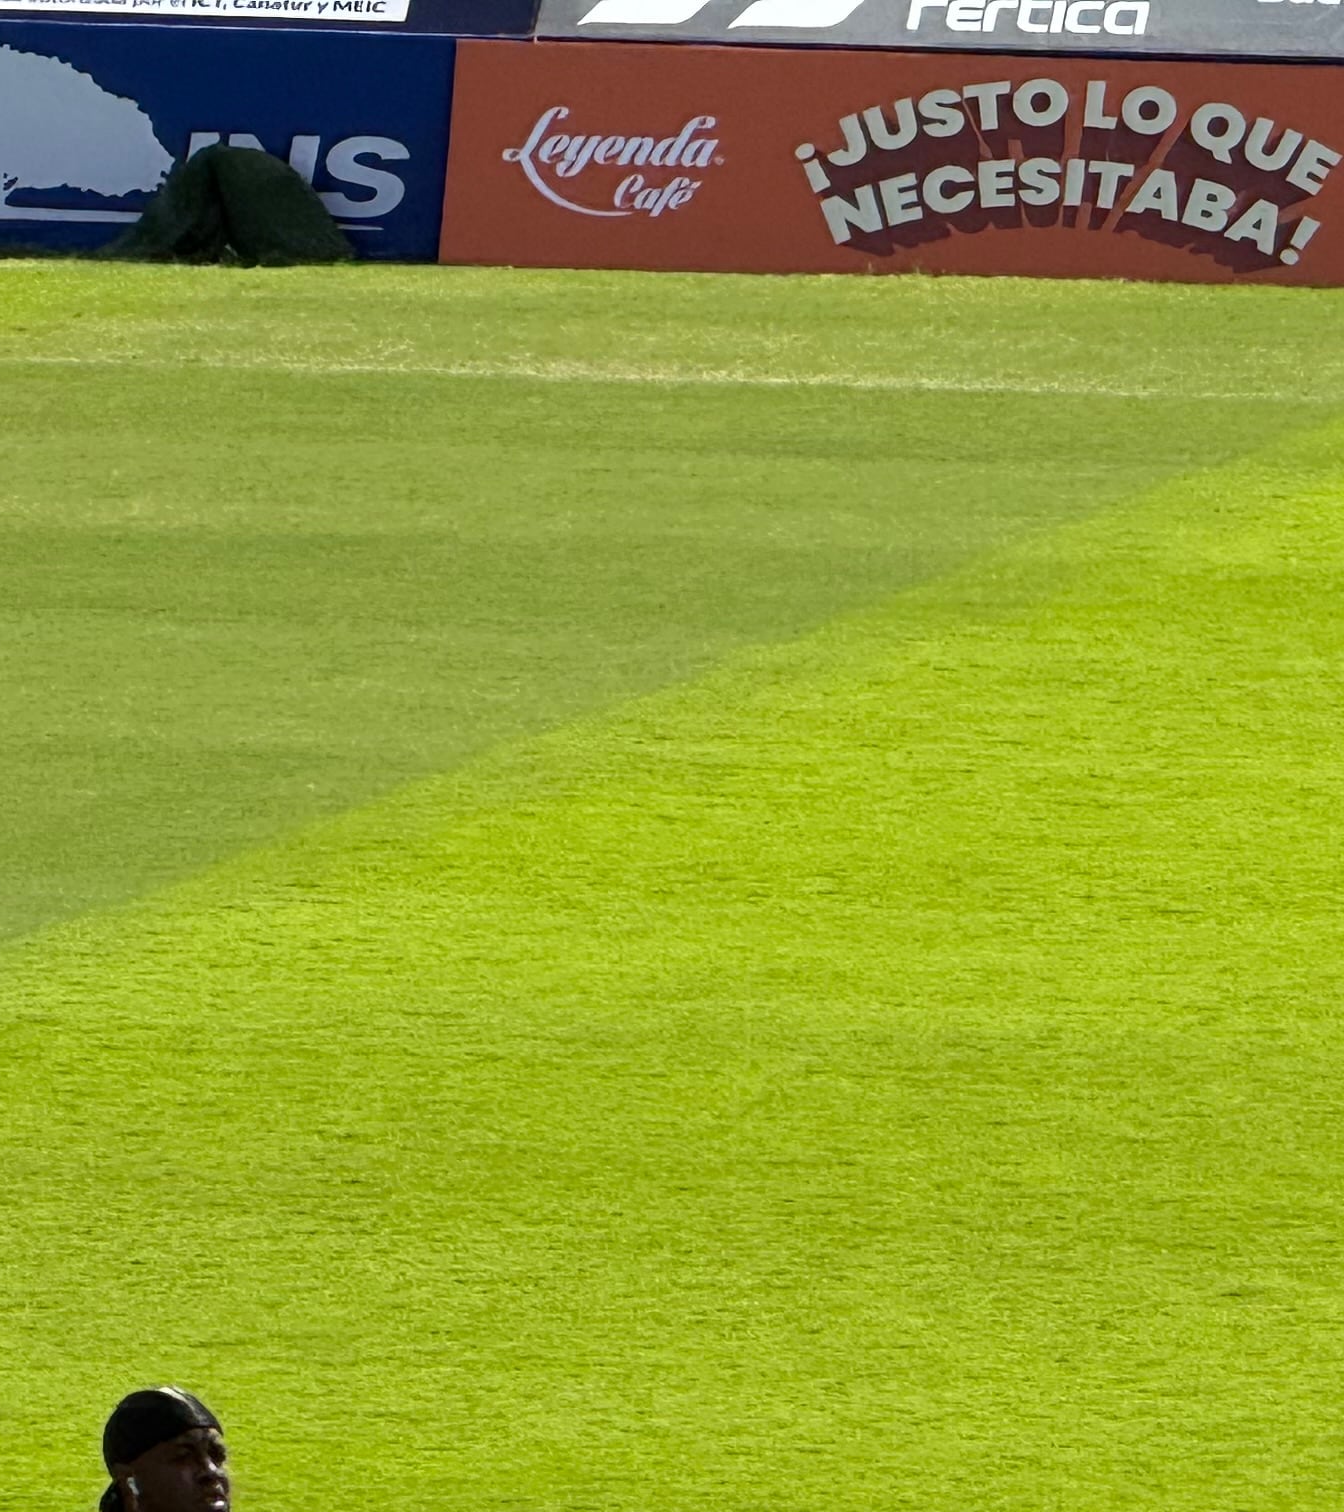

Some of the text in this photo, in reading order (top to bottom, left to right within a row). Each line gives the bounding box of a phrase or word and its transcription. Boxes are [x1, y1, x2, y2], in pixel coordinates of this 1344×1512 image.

[502, 106, 719, 216] Leyenda
[795, 78, 1343, 197] ¡JUSTO LO QUE
[613, 174, 703, 217] Café
[820, 158, 1321, 266] NECESITABA!
